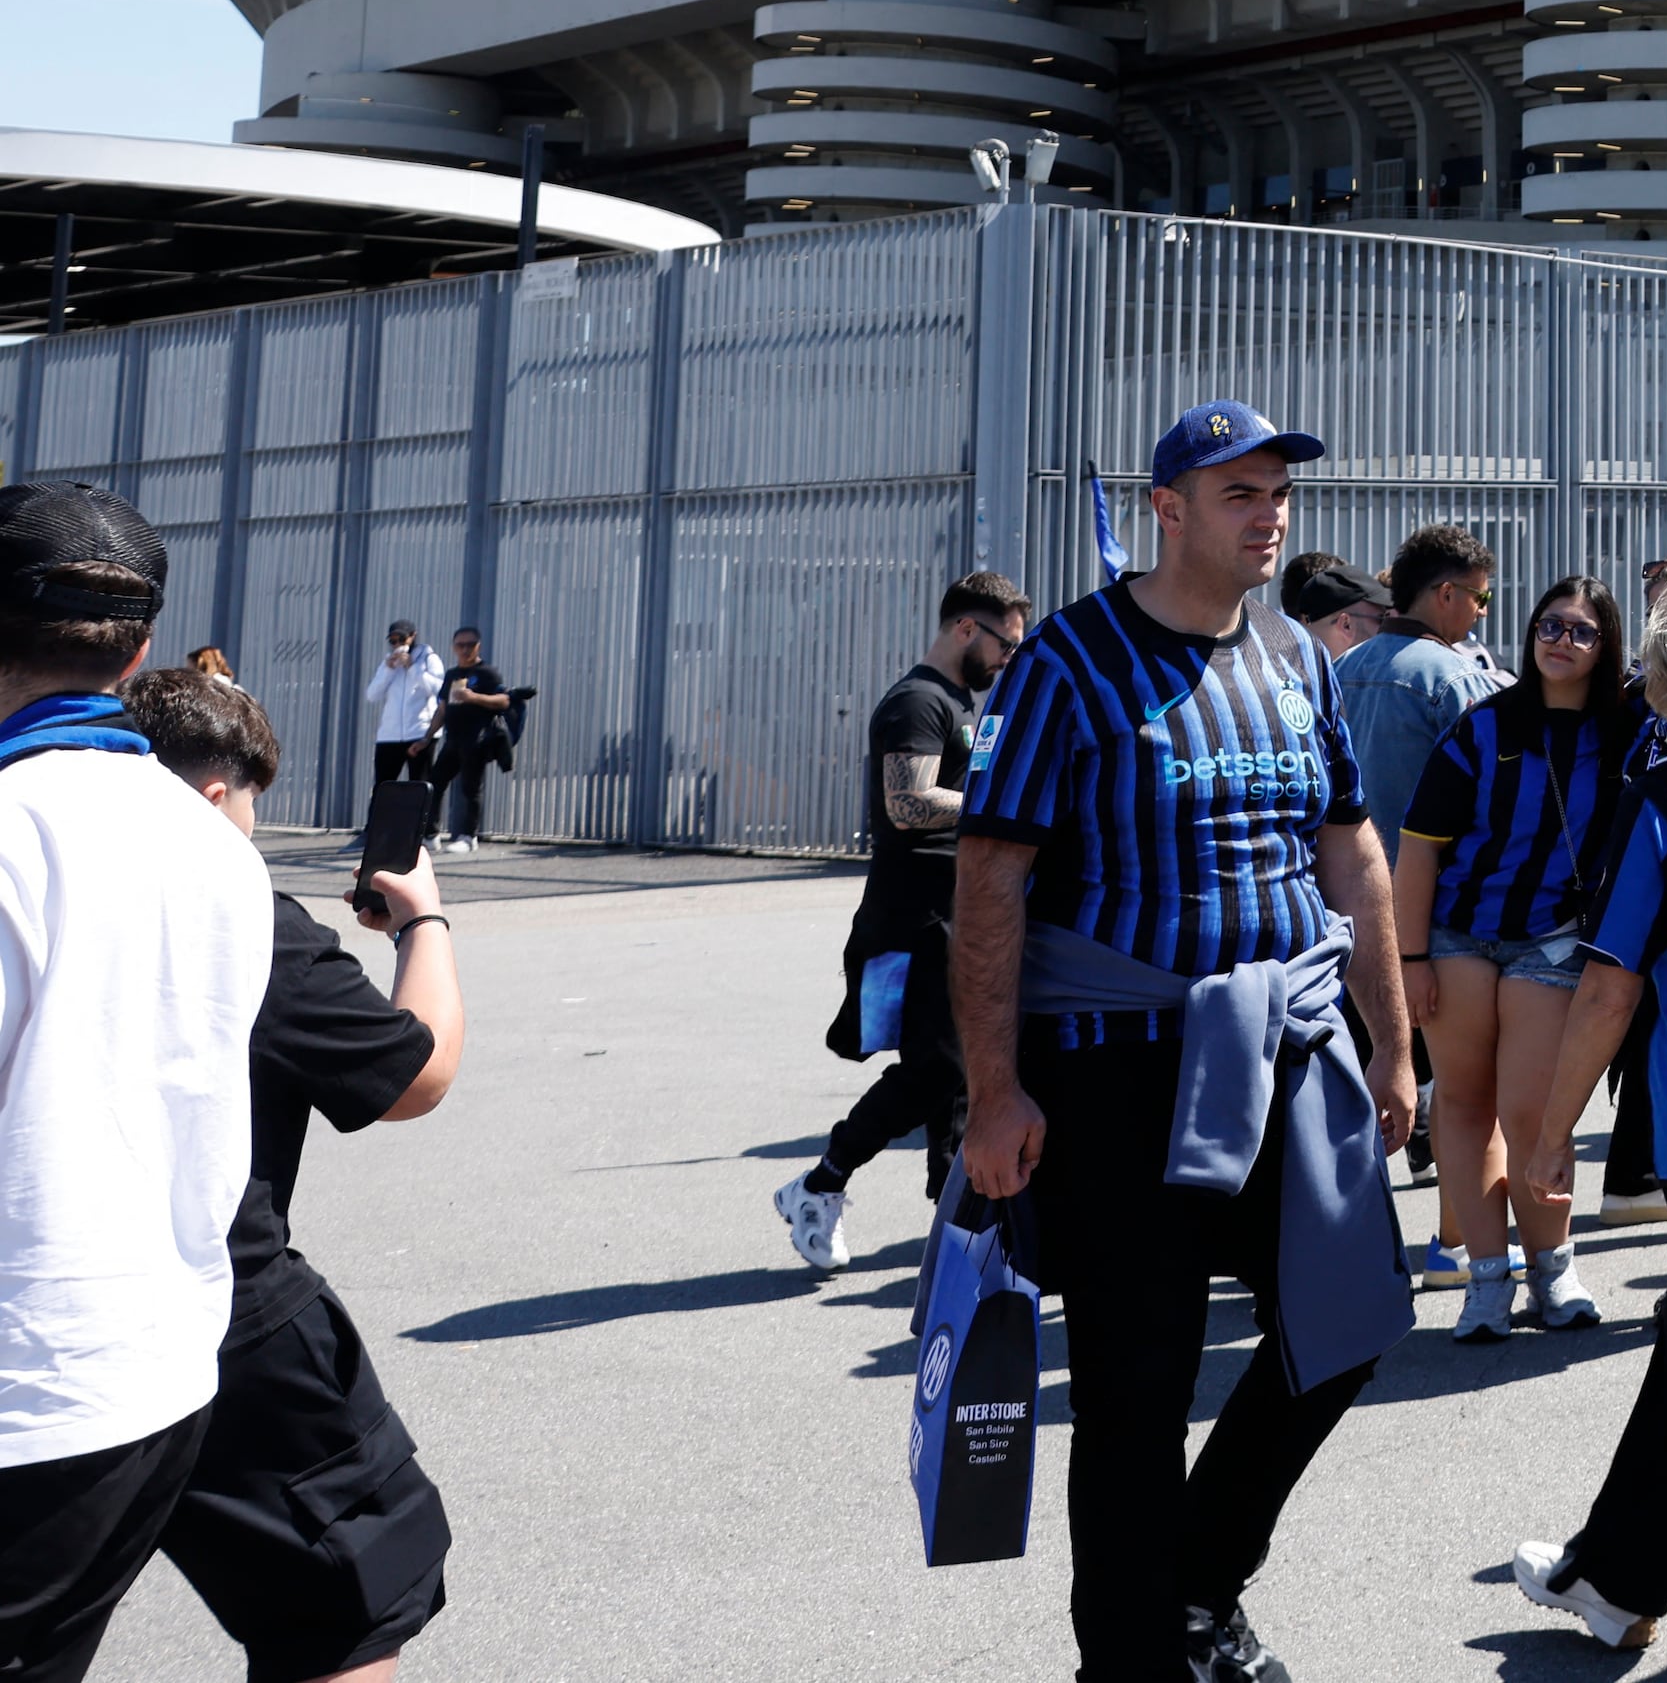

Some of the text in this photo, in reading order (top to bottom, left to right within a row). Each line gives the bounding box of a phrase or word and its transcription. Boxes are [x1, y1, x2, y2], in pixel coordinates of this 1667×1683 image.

[1163, 747, 1318, 785] betsson
[1250, 776, 1321, 803] sport
[955, 1402, 1027, 1423] INTER STORE
[966, 1424, 1015, 1436] San Babila
[969, 1438, 1009, 1450] San Siro
[968, 1453, 1007, 1464] Castello
